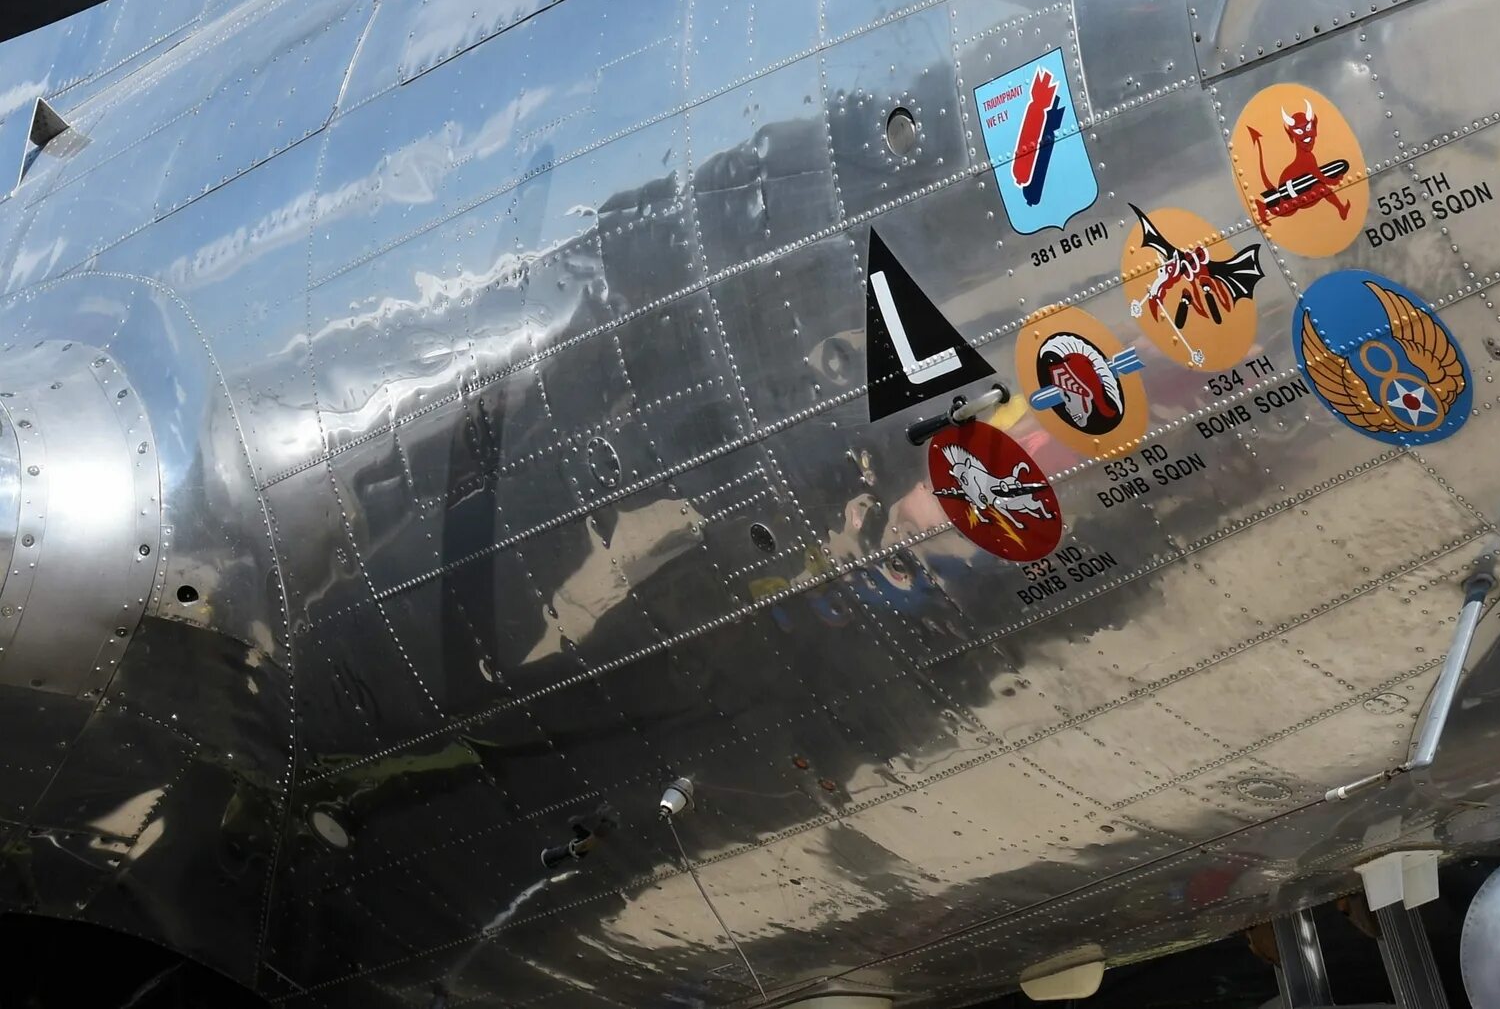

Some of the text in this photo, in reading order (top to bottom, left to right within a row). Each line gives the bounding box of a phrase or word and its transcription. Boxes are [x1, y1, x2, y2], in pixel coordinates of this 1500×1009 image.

[982, 84, 1023, 112] TRIUMPHANT
[986, 110, 1009, 129] WE FLY
[1365, 182, 1493, 248] BOMB SQDN
[1377, 172, 1451, 215] 535 TH
[1031, 221, 1109, 267] 381 BG (H)
[870, 270, 962, 384] L
[1208, 355, 1275, 396] 534 TH
[1196, 378, 1310, 439] BOMB SQDN
[1097, 453, 1207, 508] BOMB SQDN
[1104, 444, 1168, 482] 533 RD
[1017, 551, 1118, 605] BOMB SQDN
[1022, 546, 1082, 581] 532 ND
